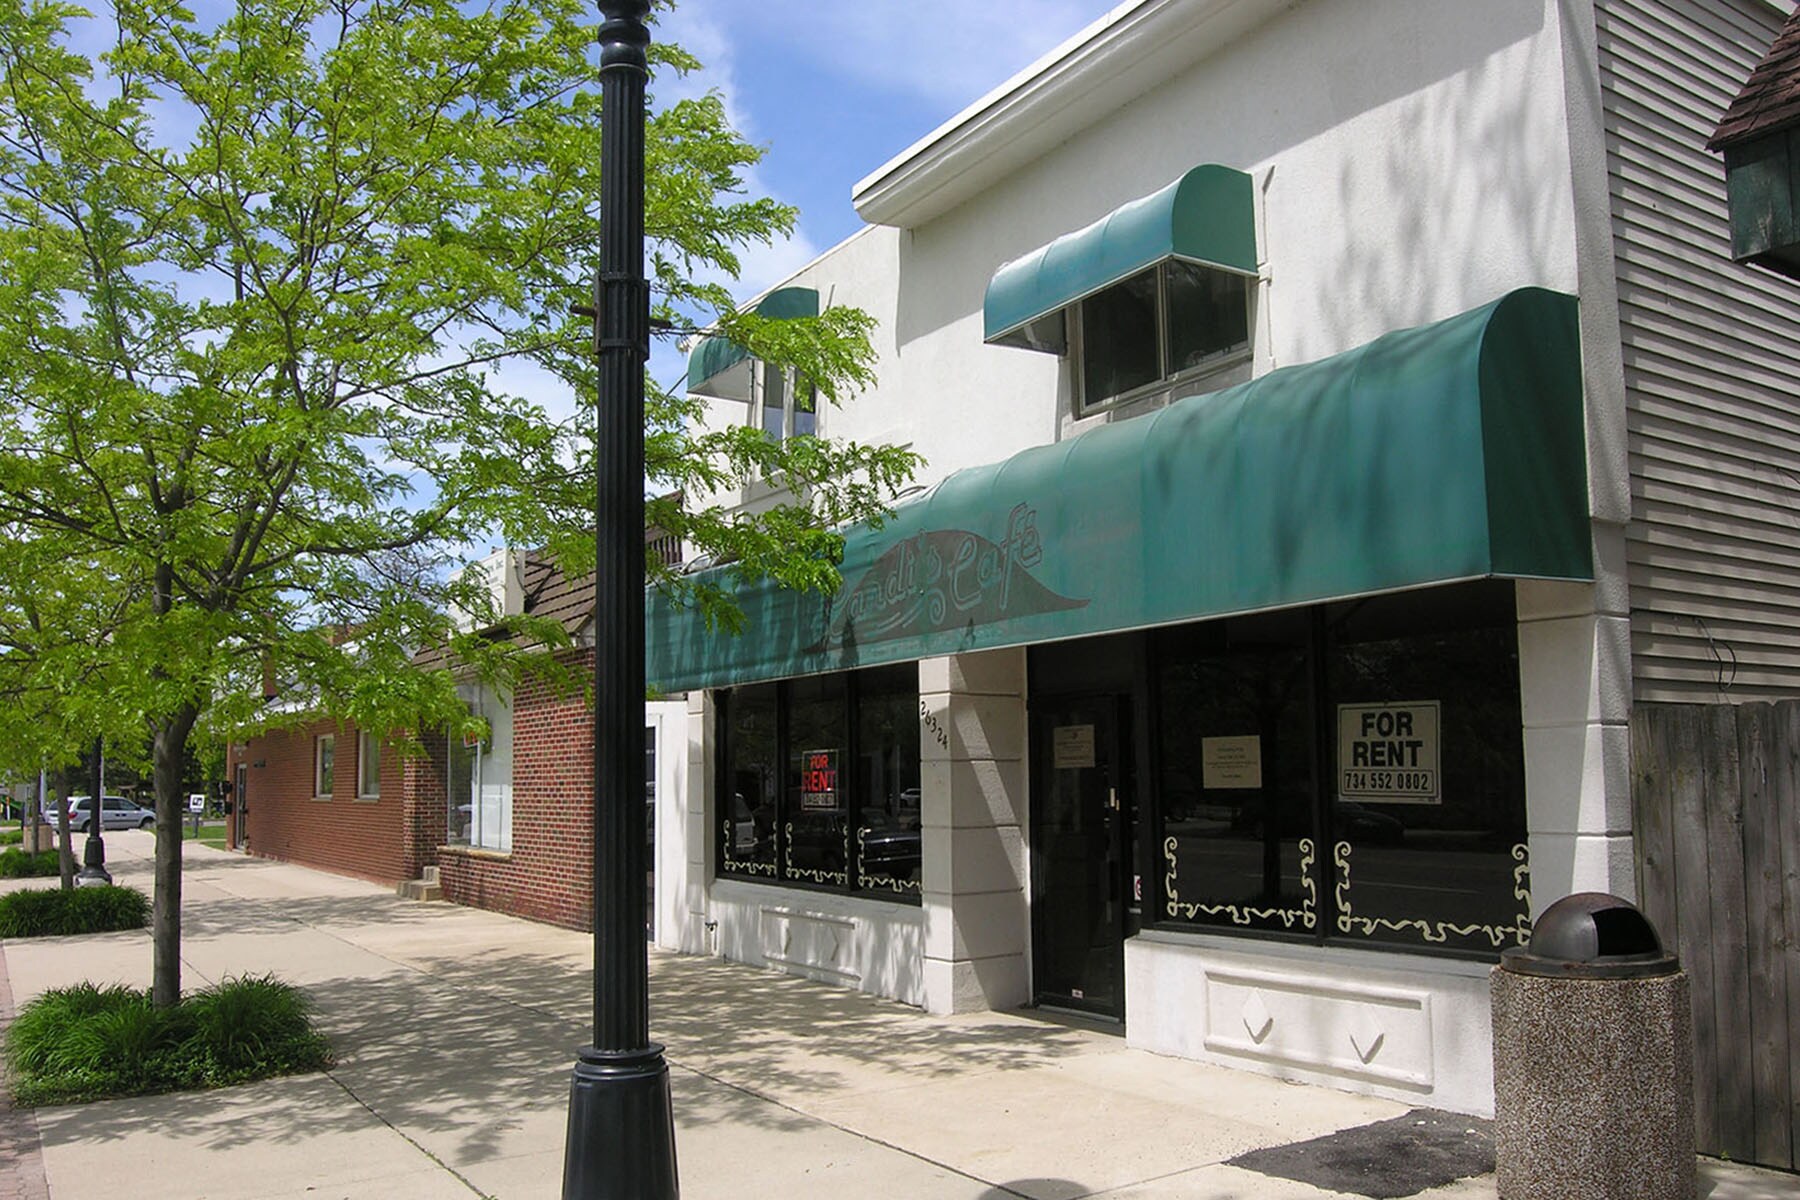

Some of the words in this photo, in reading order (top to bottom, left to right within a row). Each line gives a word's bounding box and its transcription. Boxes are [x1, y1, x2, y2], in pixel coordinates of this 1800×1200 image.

[947, 501, 1043, 611] Café
[920, 701, 949, 749] 26324
[1361, 711, 1413, 737] FOR
[809, 754, 828, 769] FOR
[1353, 741, 1423, 767] RENT
[802, 770, 836, 791] RENT
[1345, 773, 1366, 789] 734
[1370, 773, 1392, 789] 552
[1397, 773, 1428, 790] 0802
